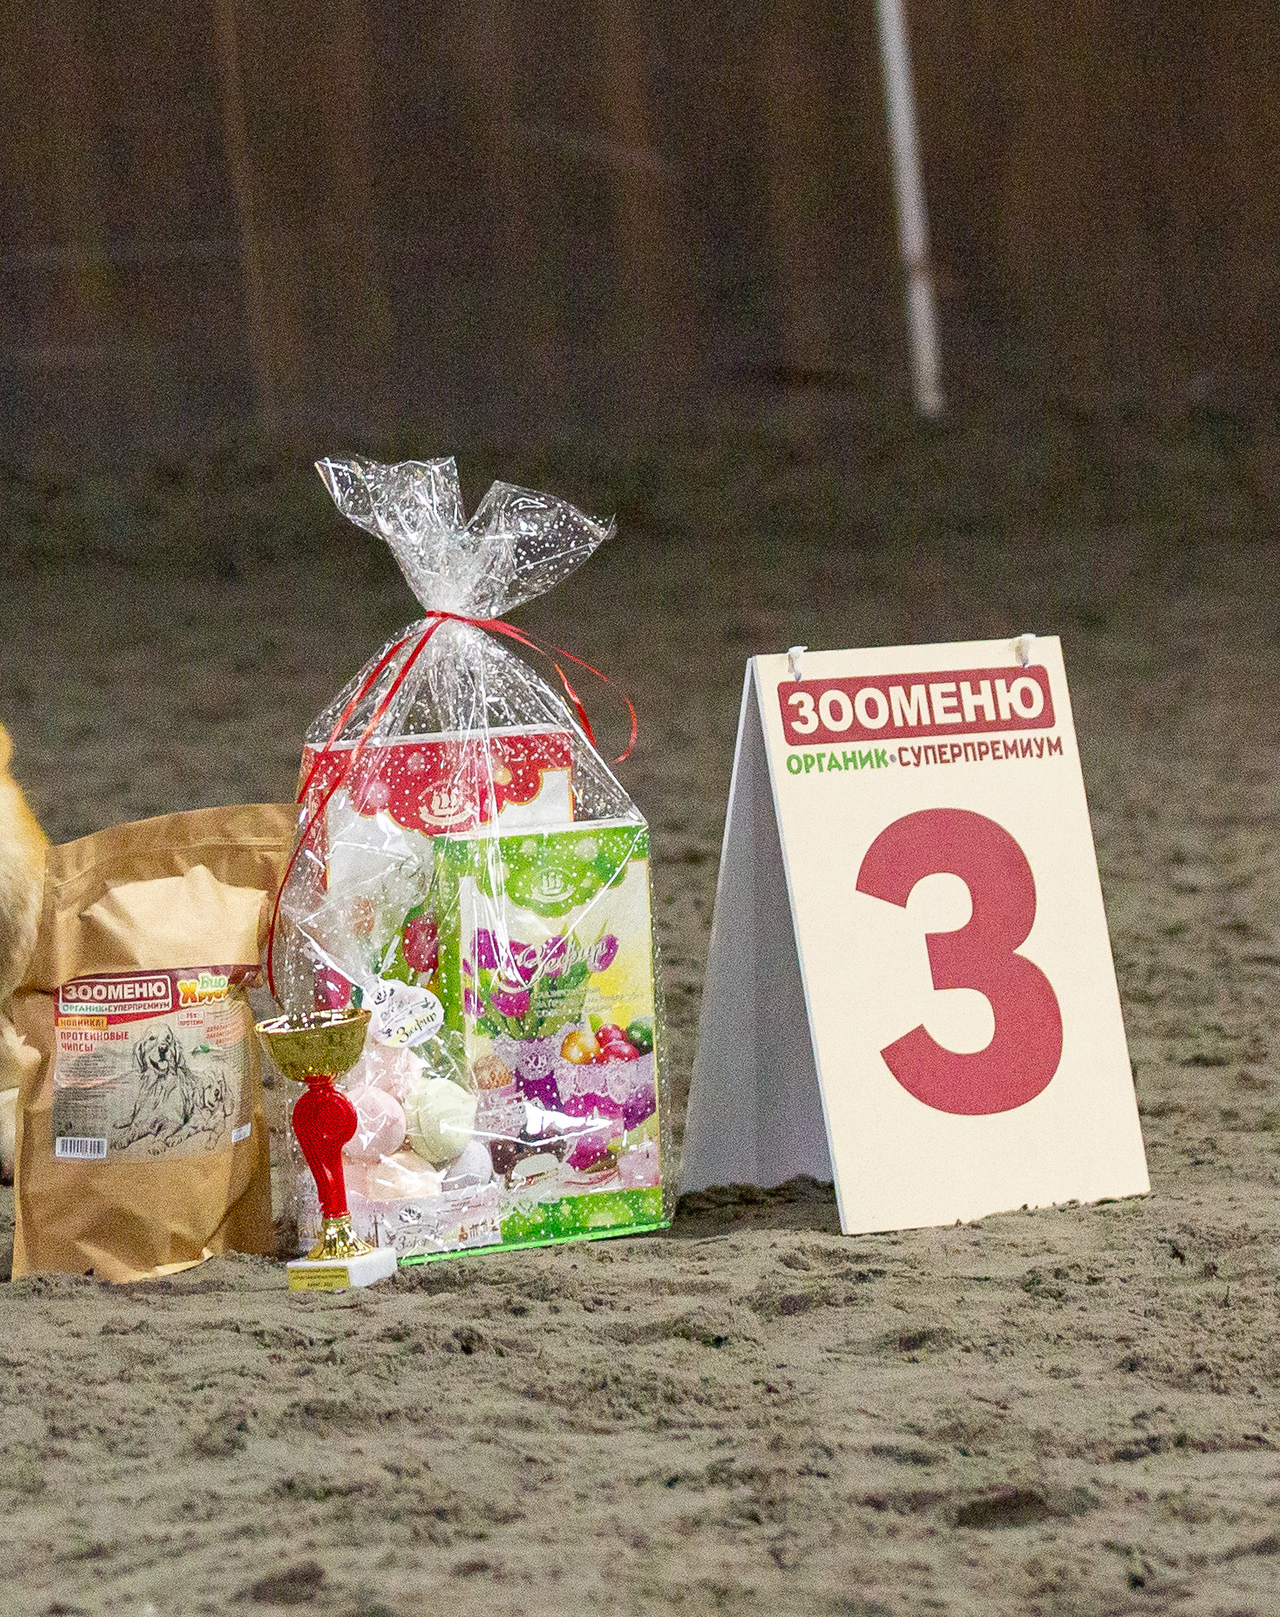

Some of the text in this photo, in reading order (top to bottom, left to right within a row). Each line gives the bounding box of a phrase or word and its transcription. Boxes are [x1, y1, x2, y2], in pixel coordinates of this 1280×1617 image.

[787, 676, 1045, 734] ЗООМЕНЮ
[855, 807, 1063, 1116] 3
[65, 981, 166, 1000] ЗООМЕНЮ
[60, 1031, 129, 1040] ПРОТЕИНОВЫЕ
[61, 1043, 93, 1052] ЧИПСЫ
